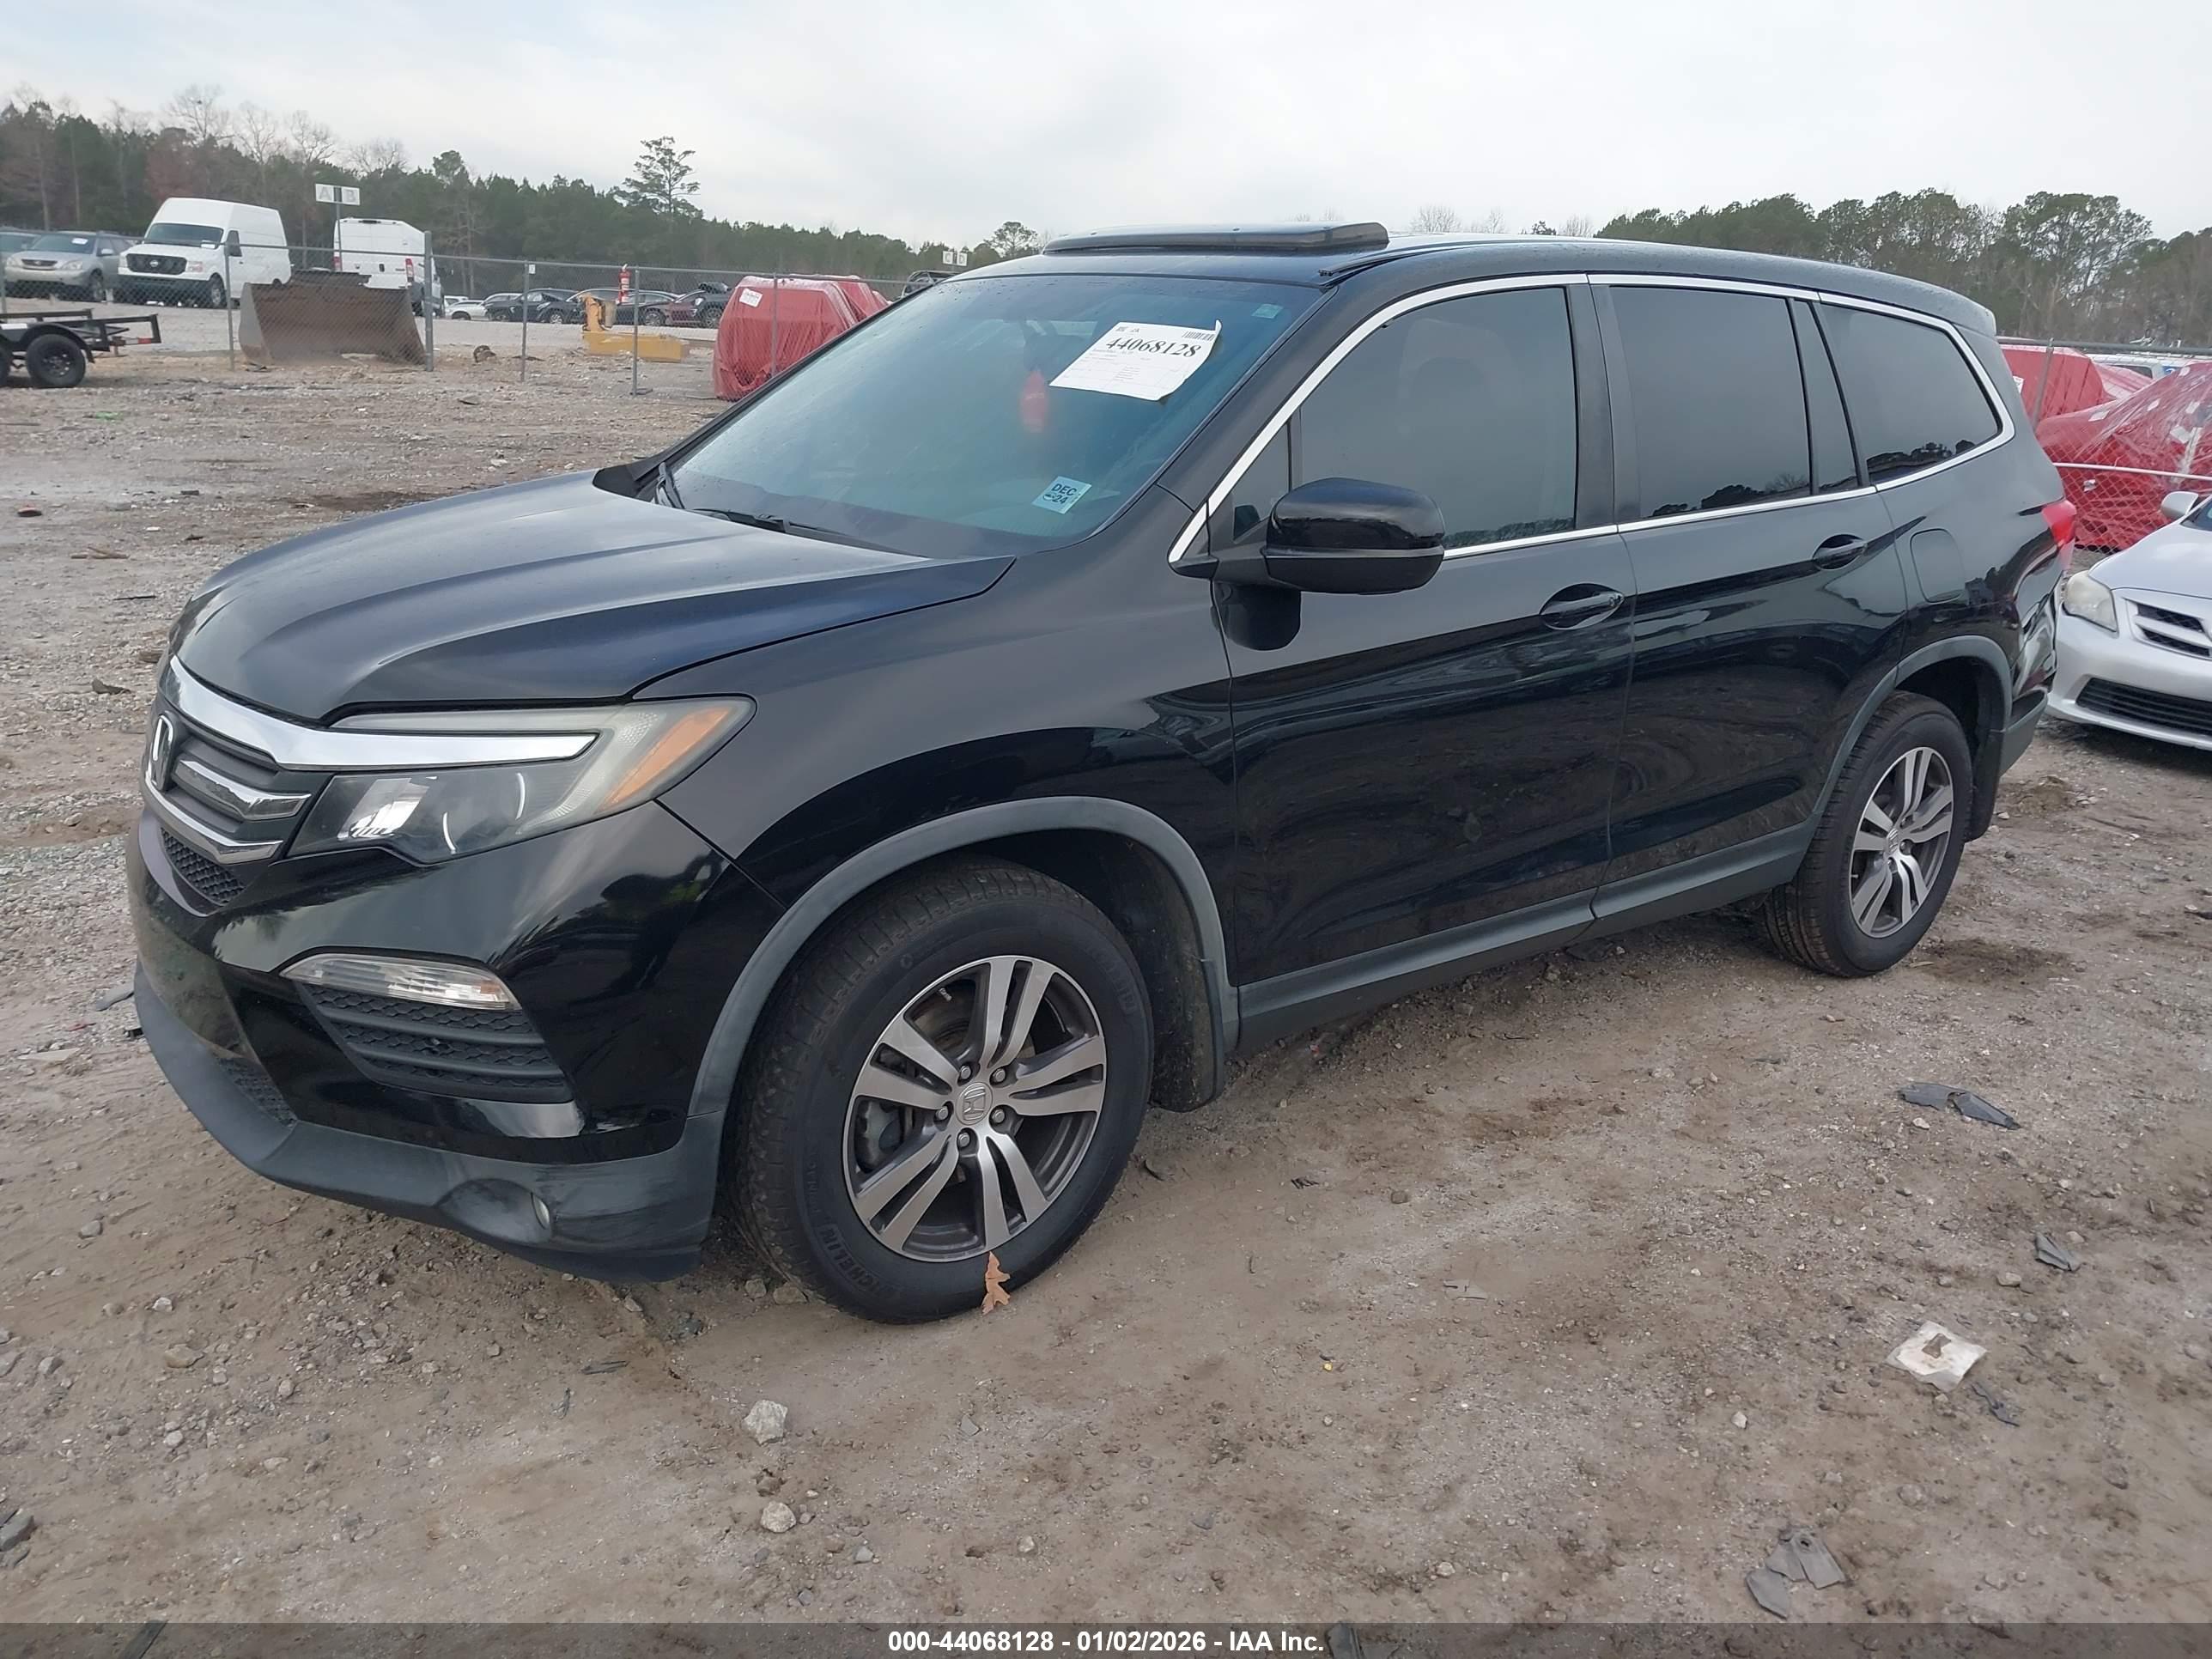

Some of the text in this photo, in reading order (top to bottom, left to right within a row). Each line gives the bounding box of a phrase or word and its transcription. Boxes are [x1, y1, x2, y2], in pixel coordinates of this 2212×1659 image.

[319, 185, 356, 203] A B
[1106, 337, 1202, 358] 44068128
[1051, 483, 1077, 495] DEC
[1052, 495, 1068, 504] 24
[819, 1226, 889, 1293] ICHELIN
